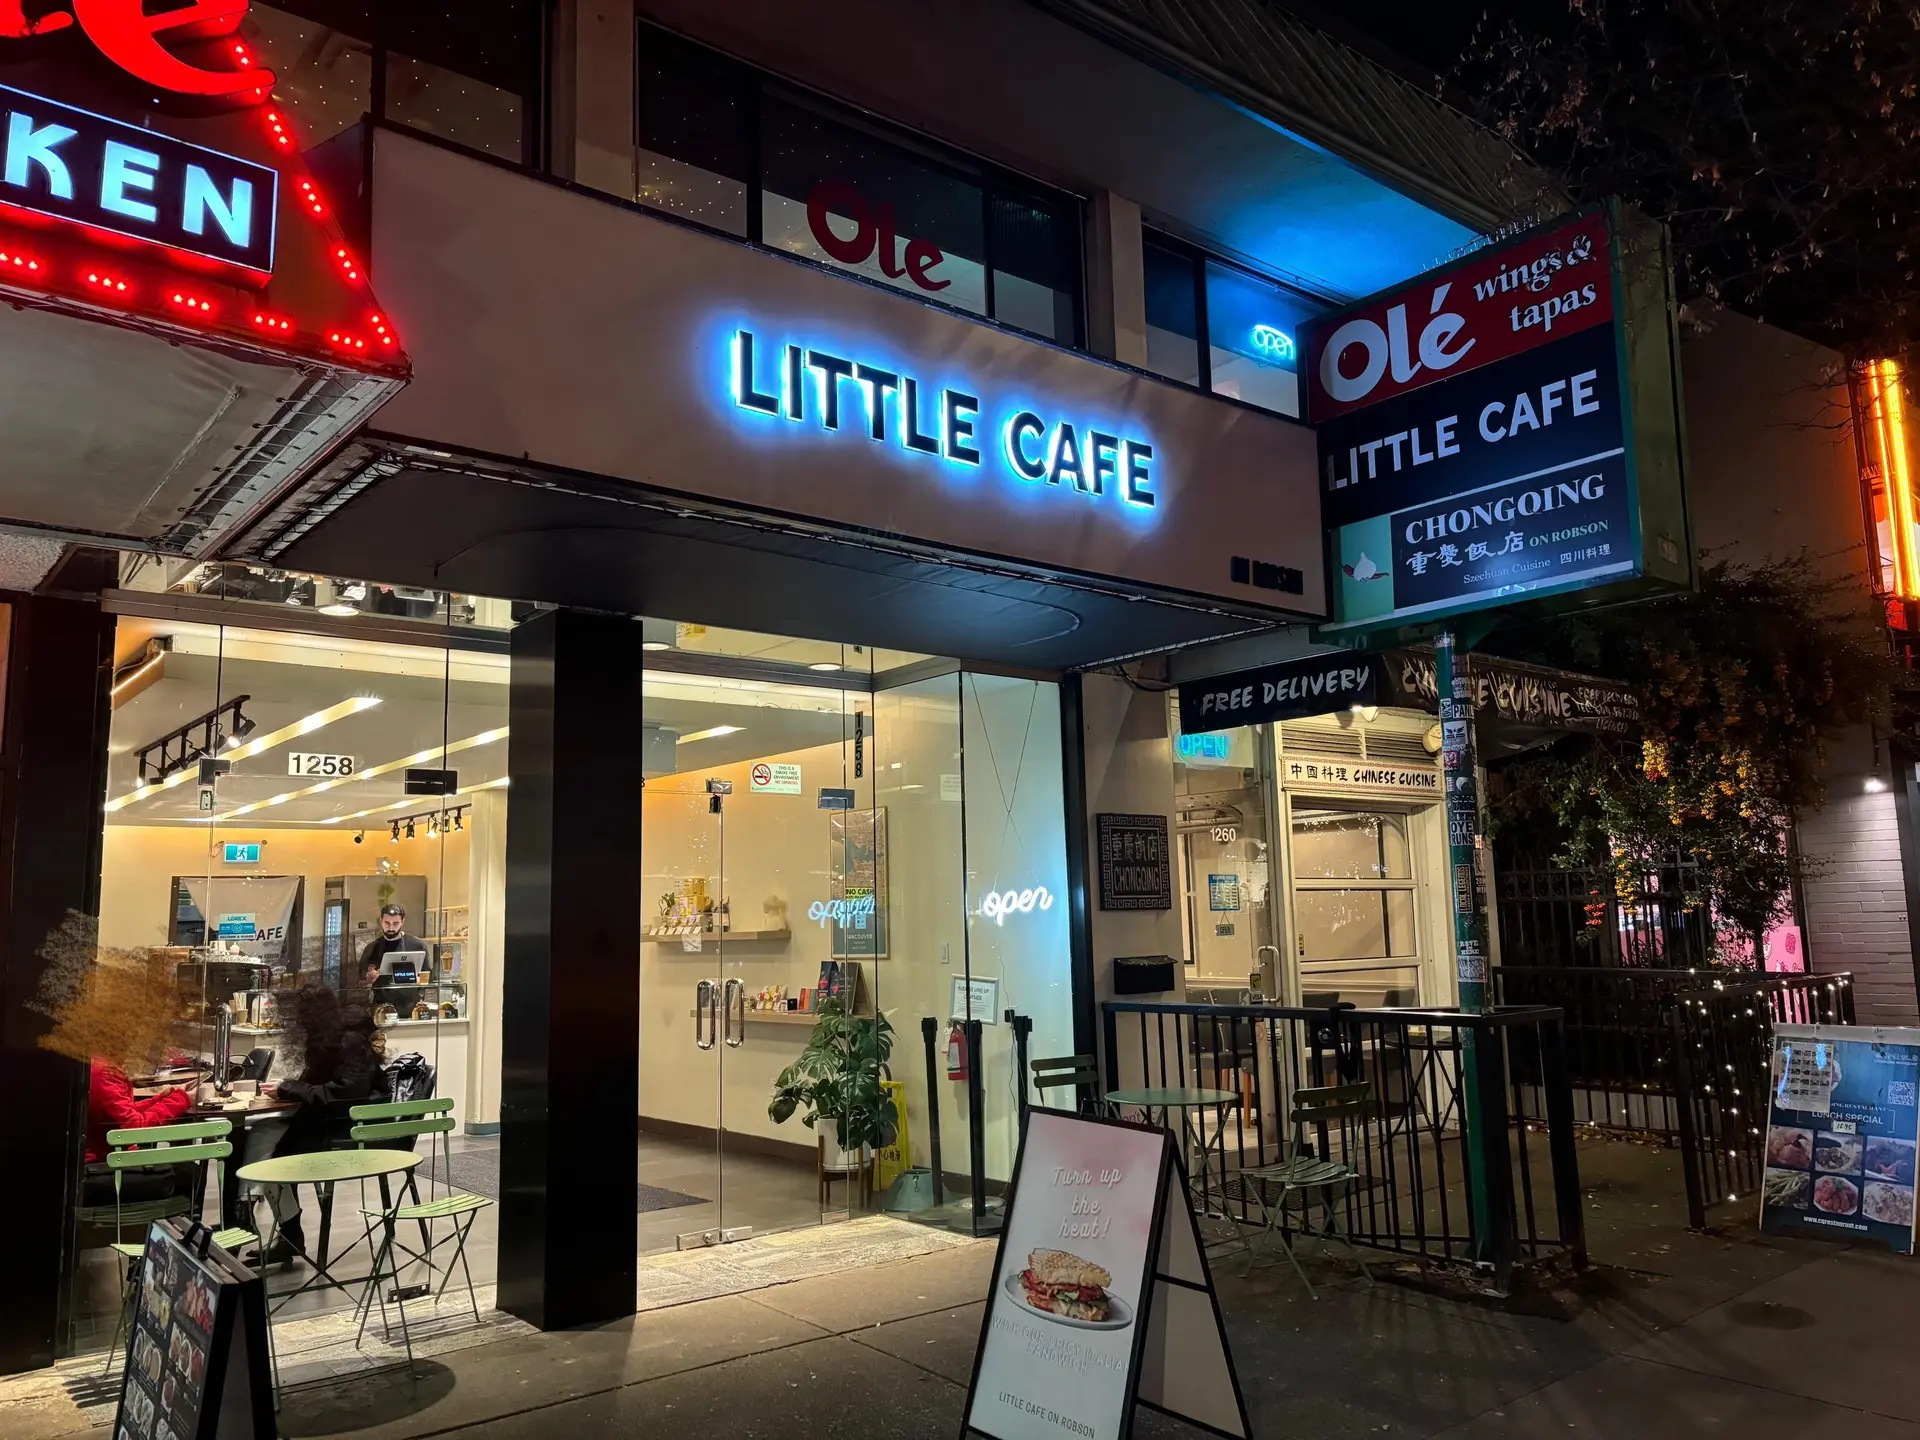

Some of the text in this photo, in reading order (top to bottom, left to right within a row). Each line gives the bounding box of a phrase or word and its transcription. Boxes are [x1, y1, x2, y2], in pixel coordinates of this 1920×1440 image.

[3, 110, 253, 248] KEN
[1473, 235, 1593, 303] wings &
[1509, 282, 1598, 333] tapas
[1253, 328, 1294, 360] open
[1319, 282, 1477, 403] Olé
[732, 329, 1156, 508] LITTLE CAFE
[1327, 369, 1600, 491] LITTLE CAFE
[1529, 520, 1609, 548] ON ROBSON
[1560, 543, 1611, 565] 四川料理
[1463, 558, 1551, 585] Szechuan Cuisine
[1200, 665, 1370, 716] FREE DELIVERY
[855, 713, 863, 778] 1258
[1179, 734, 1228, 760] OPEN
[290, 755, 353, 776] 1258
[1290, 763, 1348, 782] 中國料理
[1353, 769, 1396, 785] CHINESE
[1399, 772, 1436, 787] CUISINE
[1210, 827, 1236, 844] 1260
[1452, 833, 1474, 845] RUNS
[1113, 866, 1160, 891] CHONGQING
[982, 885, 1054, 927] open
[249, 926, 283, 941] AFE
[1053, 1166, 1122, 1189] Turn up
[1071, 1194, 1101, 1215] the
[1058, 1215, 1112, 1240] heat!
[991, 1315, 1020, 1336] WITH
[1022, 1326, 1045, 1343] OUR
[1047, 1333, 1081, 1357] SPICY
[1026, 1341, 1089, 1376] SANDWICH
[998, 1391, 1096, 1439] LITTLE CAFE ON ROBSON
